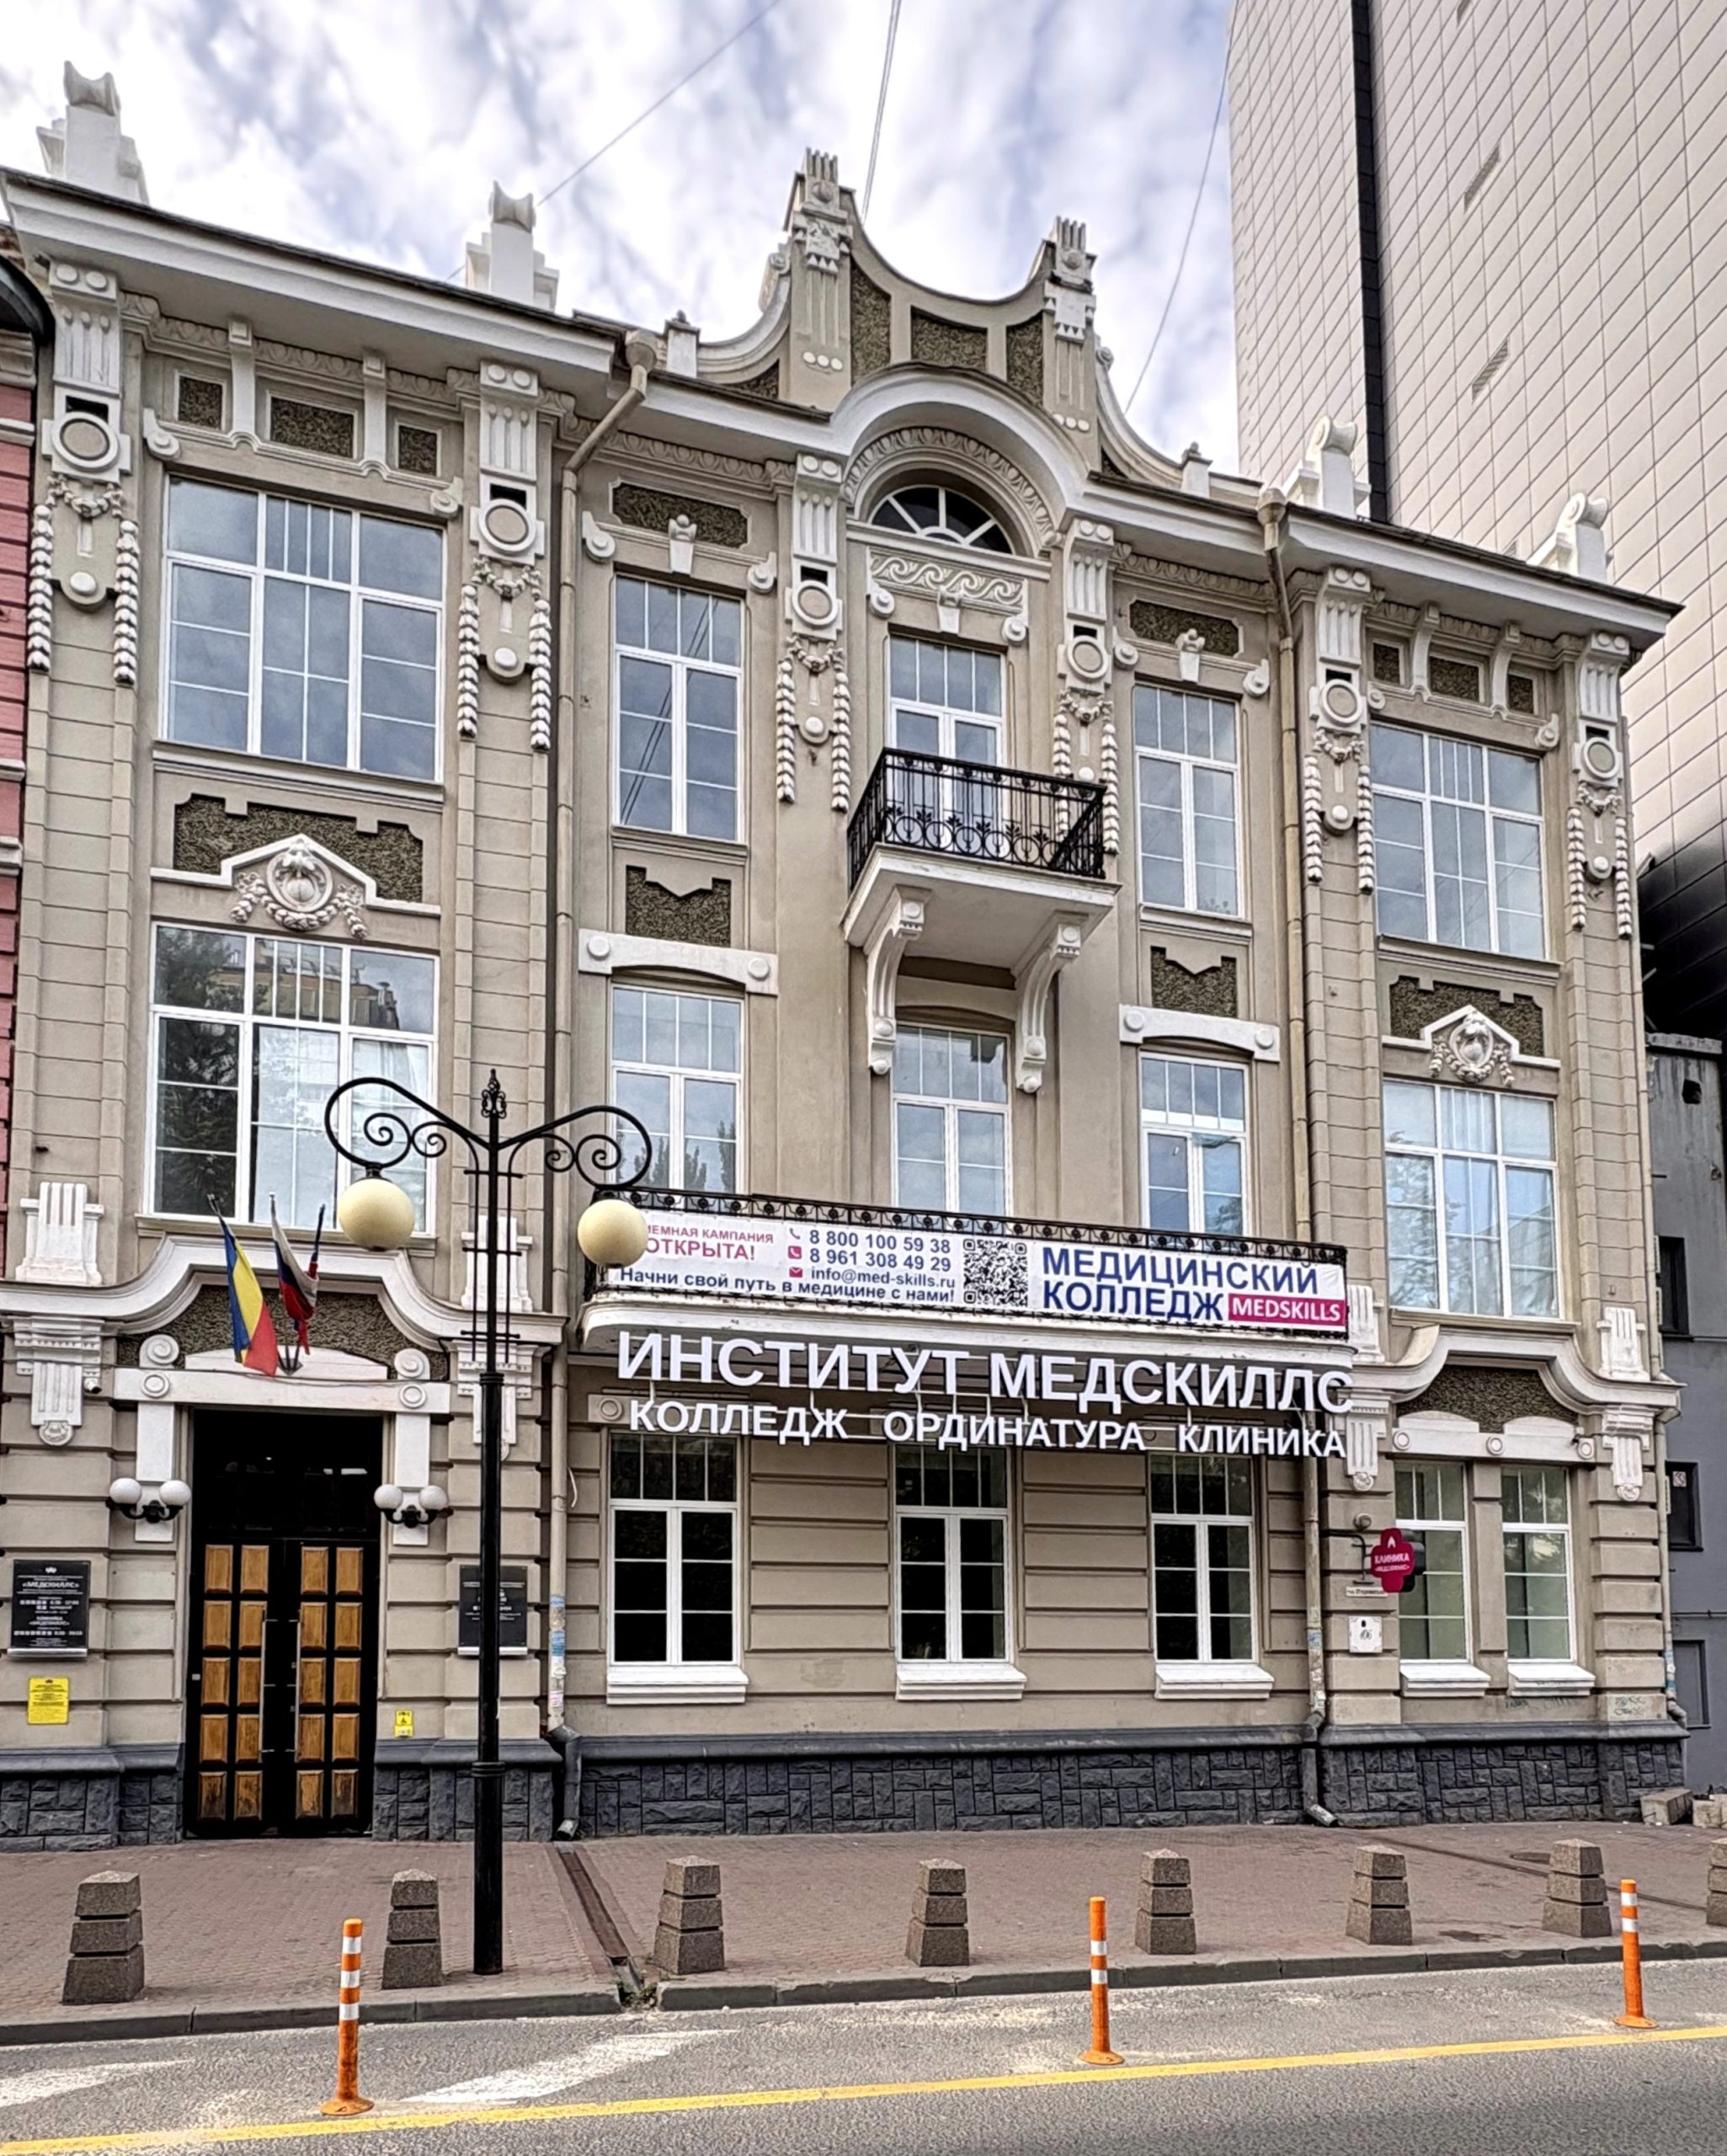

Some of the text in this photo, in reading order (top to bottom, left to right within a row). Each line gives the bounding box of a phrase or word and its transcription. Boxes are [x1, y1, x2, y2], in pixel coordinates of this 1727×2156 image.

[702, 1228, 774, 1244] КАМПАНИЯ
[809, 1229, 951, 1254] 8 800 100 59 38
[646, 1238, 755, 1261] ОТКРЫТА!
[809, 1248, 951, 1273] 8 961 308 49 29
[811, 1266, 956, 1289] info@med-skills.ru
[1042, 1246, 1319, 1294] МЕДИЦИНСКИЙ
[621, 1267, 955, 1304] Начни свой путь в медицине с нами!
[1043, 1280, 1224, 1321] КОЛЛЕДЖ
[1232, 1298, 1341, 1322] MEDSKILLS
[617, 1331, 1354, 1415] ИНСТИТУТ МЕДСКИЛЛС
[630, 1399, 1347, 1459] КОЛЛЕДЖ ОРДИНАТУРА КЛИНИКА
[1374, 1553, 1410, 1564] КЛИНИКА
